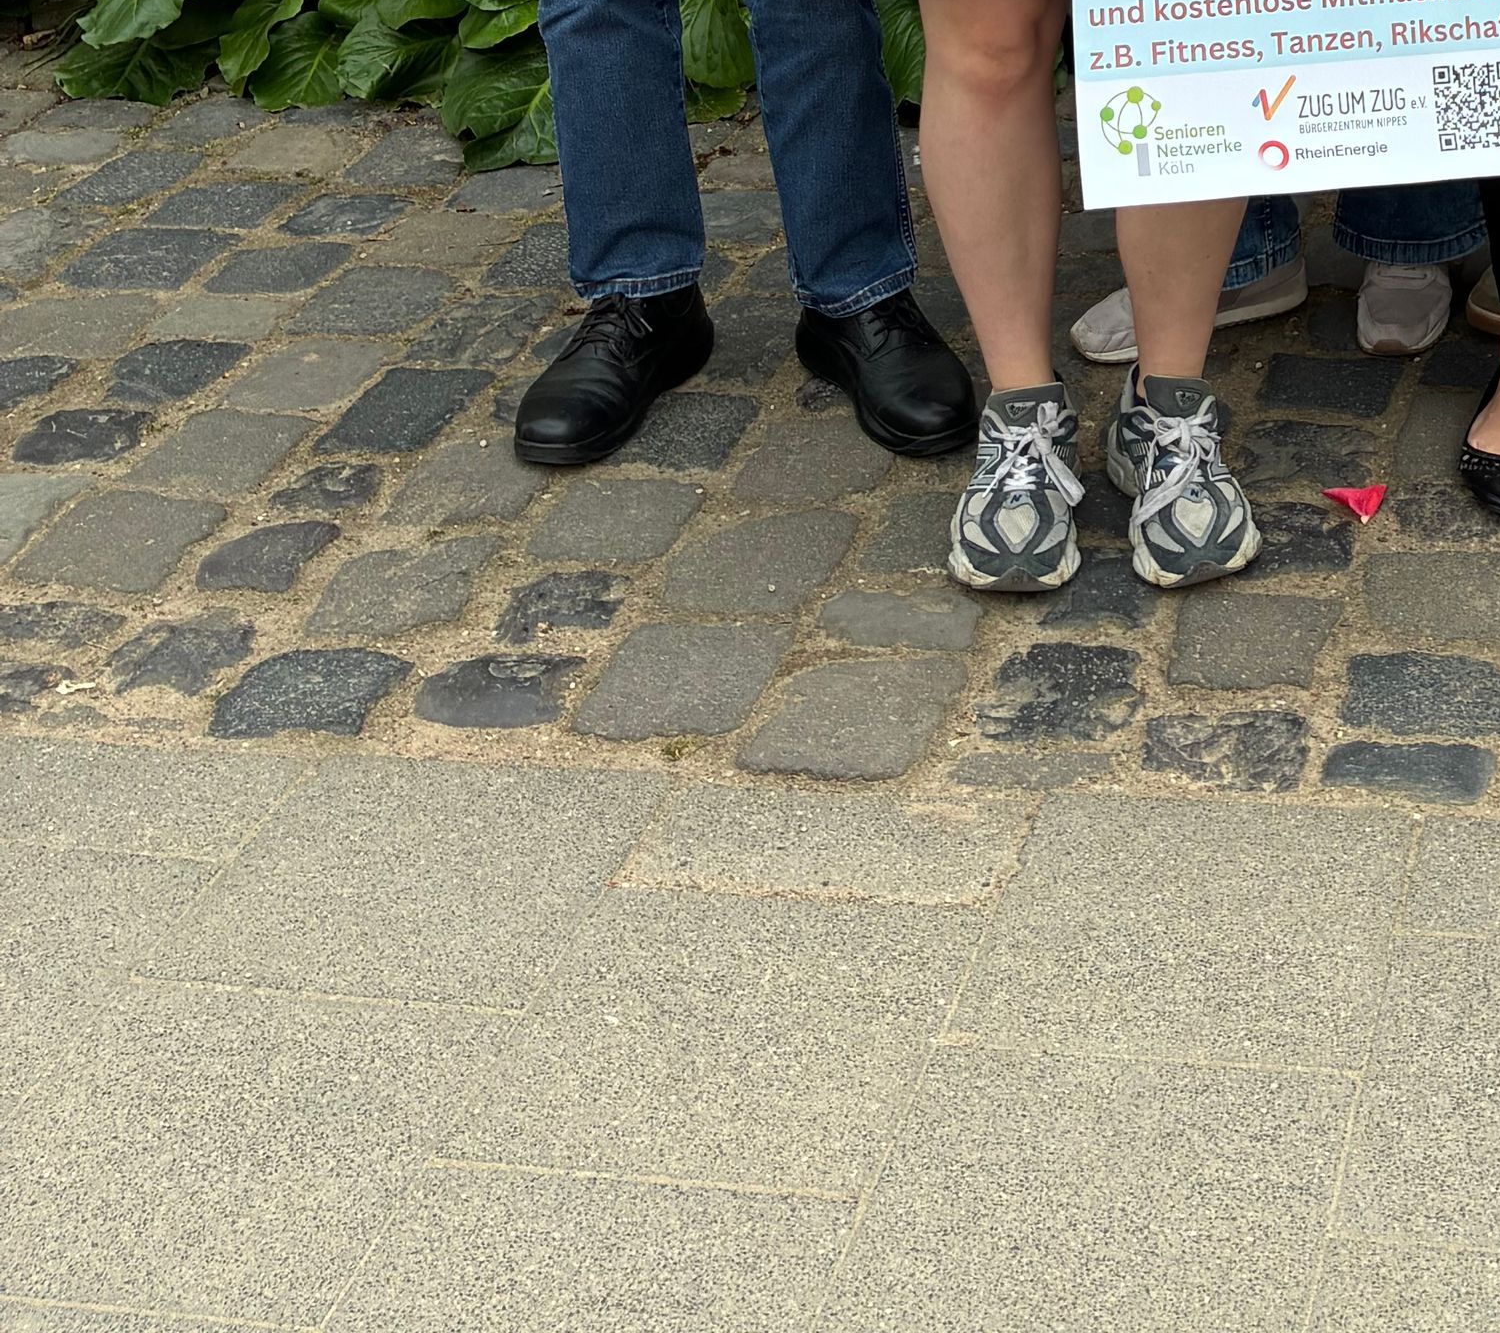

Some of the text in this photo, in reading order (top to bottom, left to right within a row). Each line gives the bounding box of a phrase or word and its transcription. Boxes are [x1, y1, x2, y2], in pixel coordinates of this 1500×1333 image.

[1089, 1, 1147, 28] und
[1089, 44, 1143, 71] z.B.
[1150, 33, 1264, 67] Fitness,
[1270, 26, 1383, 58] Tanzen,
[1298, 87, 1428, 119] ZUG UM ZUG e.V.
[1154, 123, 1225, 141] Senioren
[1299, 115, 1407, 134] BÜRGERZENTRUM NIPPES
[1156, 139, 1243, 157] Netzwerke
[1295, 142, 1388, 161] RheinEnergie
[1158, 160, 1195, 175] Köln
